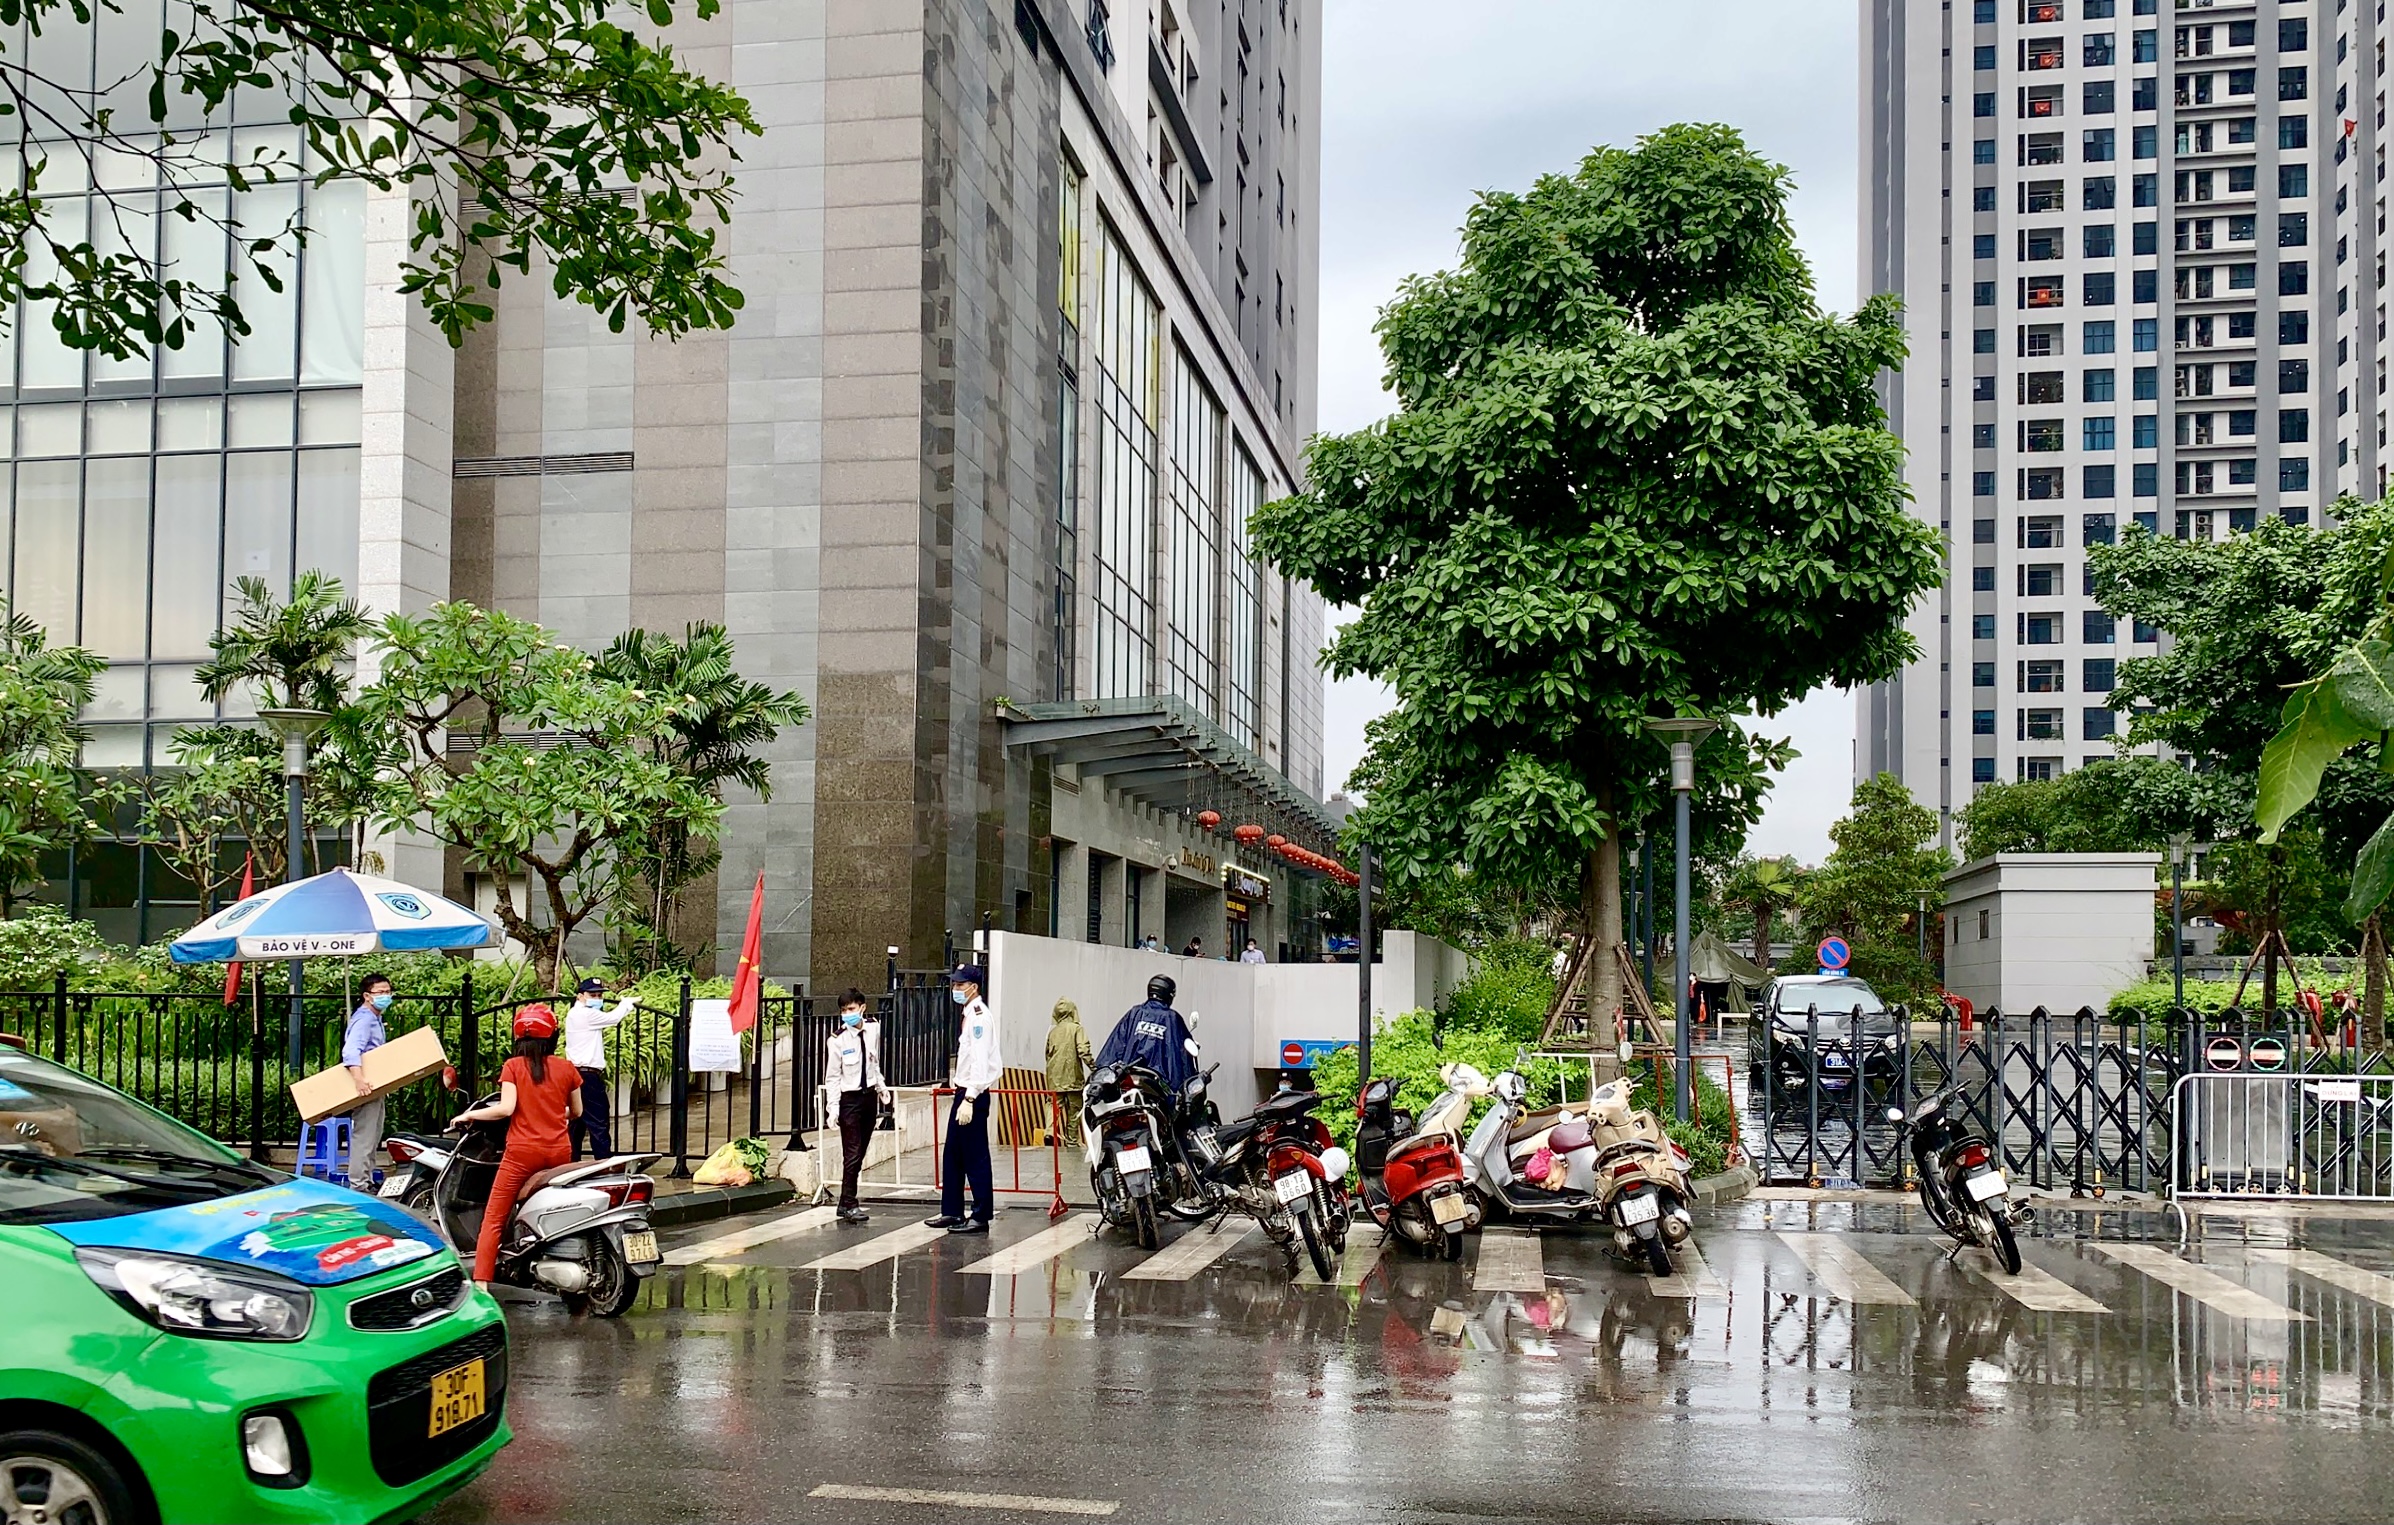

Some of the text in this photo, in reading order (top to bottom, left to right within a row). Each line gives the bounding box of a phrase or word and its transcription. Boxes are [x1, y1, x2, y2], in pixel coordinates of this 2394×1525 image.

[262, 939, 289, 952] BẢO
[292, 939, 307, 954] VỆ
[311, 941, 319, 951] V
[330, 940, 356, 951] ONE
[1282, 1183, 1308, 1200] 9660
